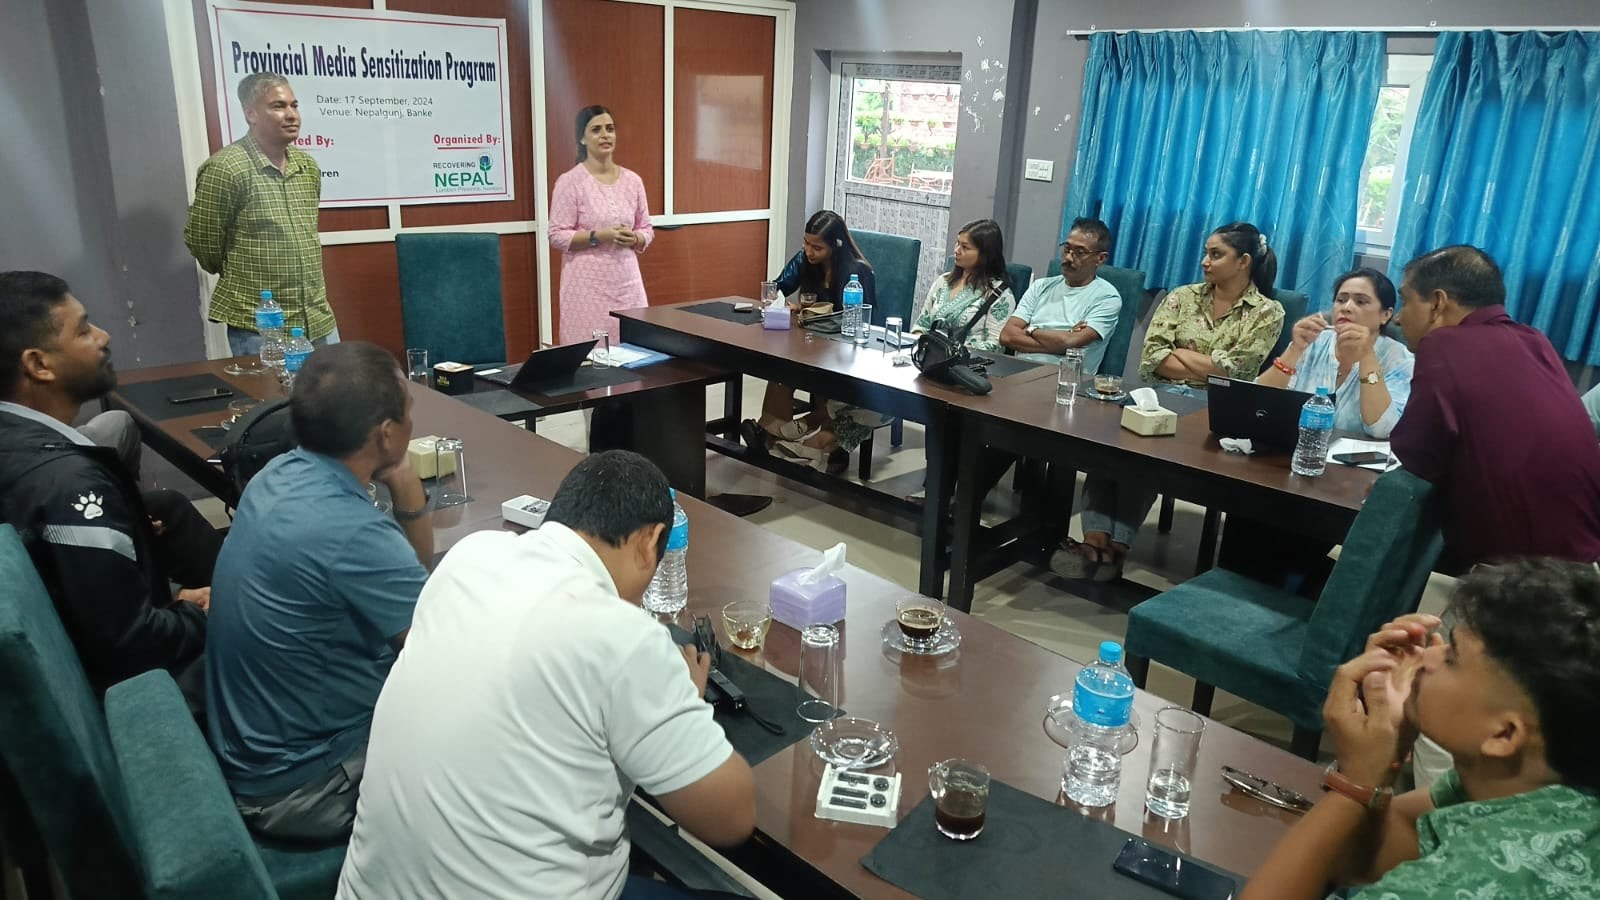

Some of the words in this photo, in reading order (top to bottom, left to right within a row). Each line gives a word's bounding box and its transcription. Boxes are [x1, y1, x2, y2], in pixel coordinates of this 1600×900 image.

[231, 41, 308, 76] Provincial
[312, 44, 357, 78] Media
[361, 46, 442, 80] Sensitization
[445, 51, 496, 88] Program
[316, 95, 341, 104] Date:
[345, 96, 355, 104] 17
[359, 96, 409, 107] September,
[412, 97, 433, 105] 2024
[320, 108, 352, 116] Venue:
[355, 108, 404, 119] Nepalgunj,
[407, 109, 432, 117] Banke
[316, 135, 334, 148] By:
[434, 133, 483, 146] Organized
[486, 134, 501, 146] By:
[433, 161, 476, 169] RECOVERING
[435, 169, 494, 187] NEPAL
